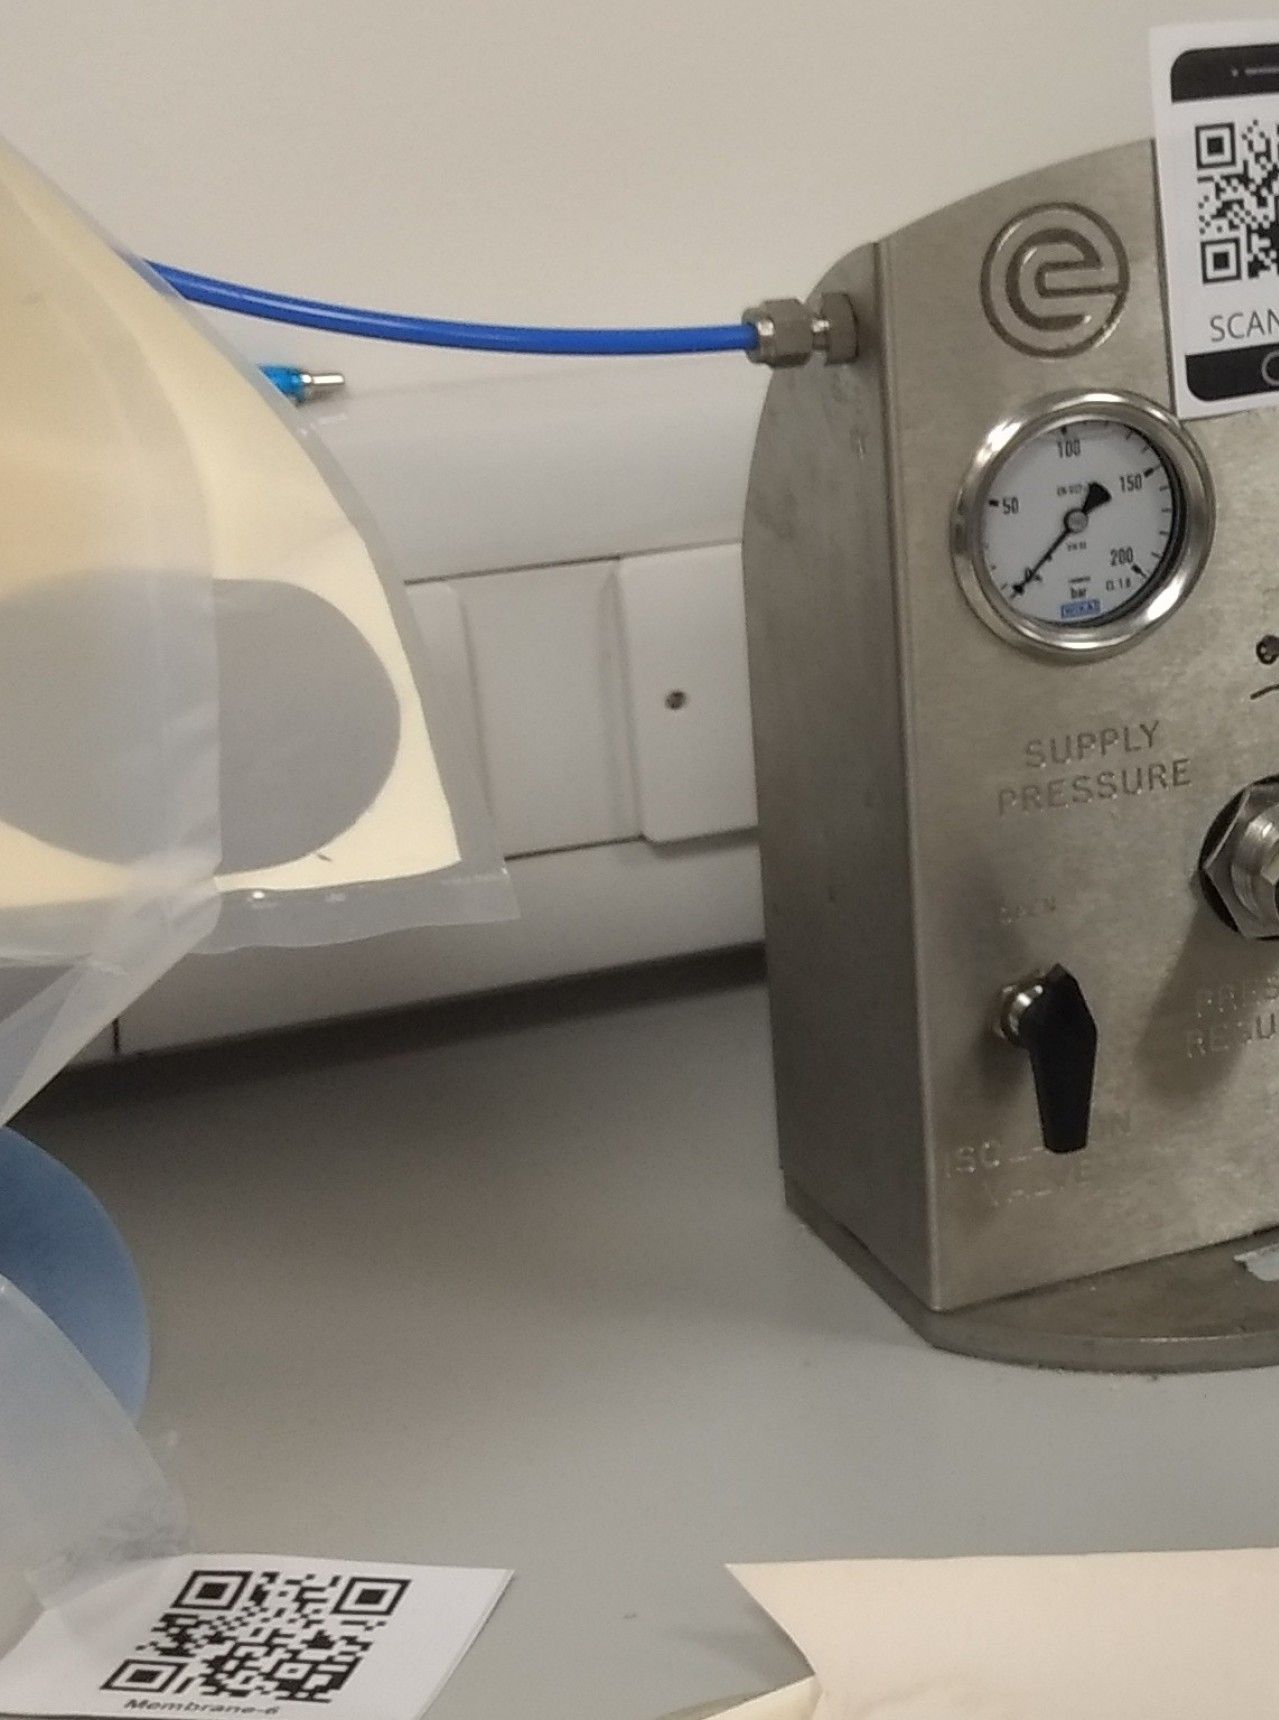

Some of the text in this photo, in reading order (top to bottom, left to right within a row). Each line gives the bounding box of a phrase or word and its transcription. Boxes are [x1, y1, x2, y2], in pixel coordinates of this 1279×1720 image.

[1056, 439, 1080, 458] 100
[1119, 474, 1142, 493] 150
[1002, 497, 1019, 514] 50
[1110, 547, 1134, 567] 200
[1025, 720, 1160, 768] SUPPLY
[998, 758, 1192, 816] PRESSURE
